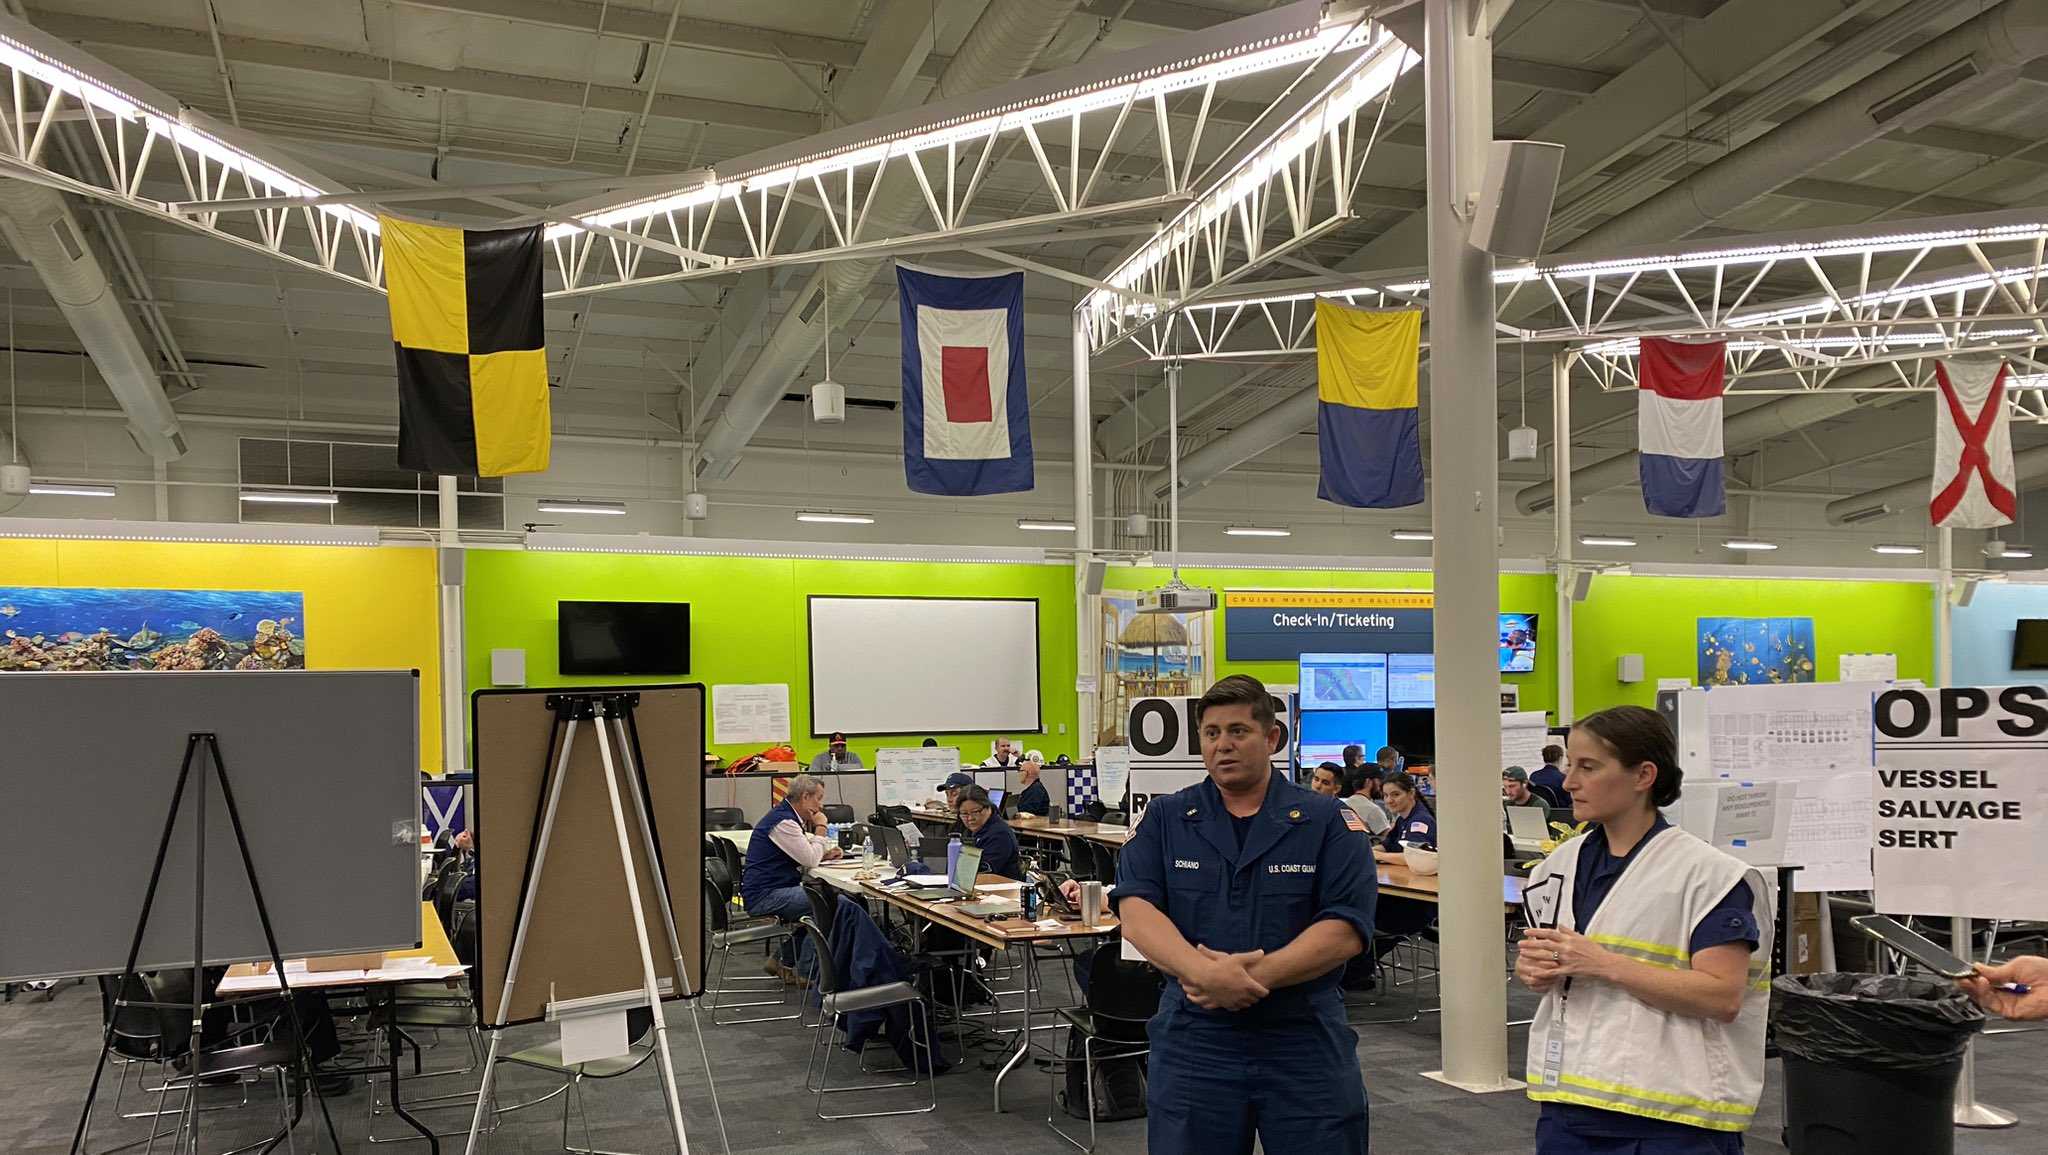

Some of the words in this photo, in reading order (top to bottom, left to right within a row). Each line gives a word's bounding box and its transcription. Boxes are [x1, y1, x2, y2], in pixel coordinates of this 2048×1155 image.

[1282, 596, 1344, 604] MARYLAND
[1369, 597, 1432, 605] BALTIMORE
[1272, 612, 1395, 630] Check-In/Ticketing
[1874, 685, 2048, 739] OPS
[1878, 769, 1998, 789] VESSEL
[1878, 800, 2022, 820] SALVAGE
[1878, 829, 1959, 849] SERT
[1268, 864, 1281, 874] U.S.
[1281, 864, 1301, 873] COAST
